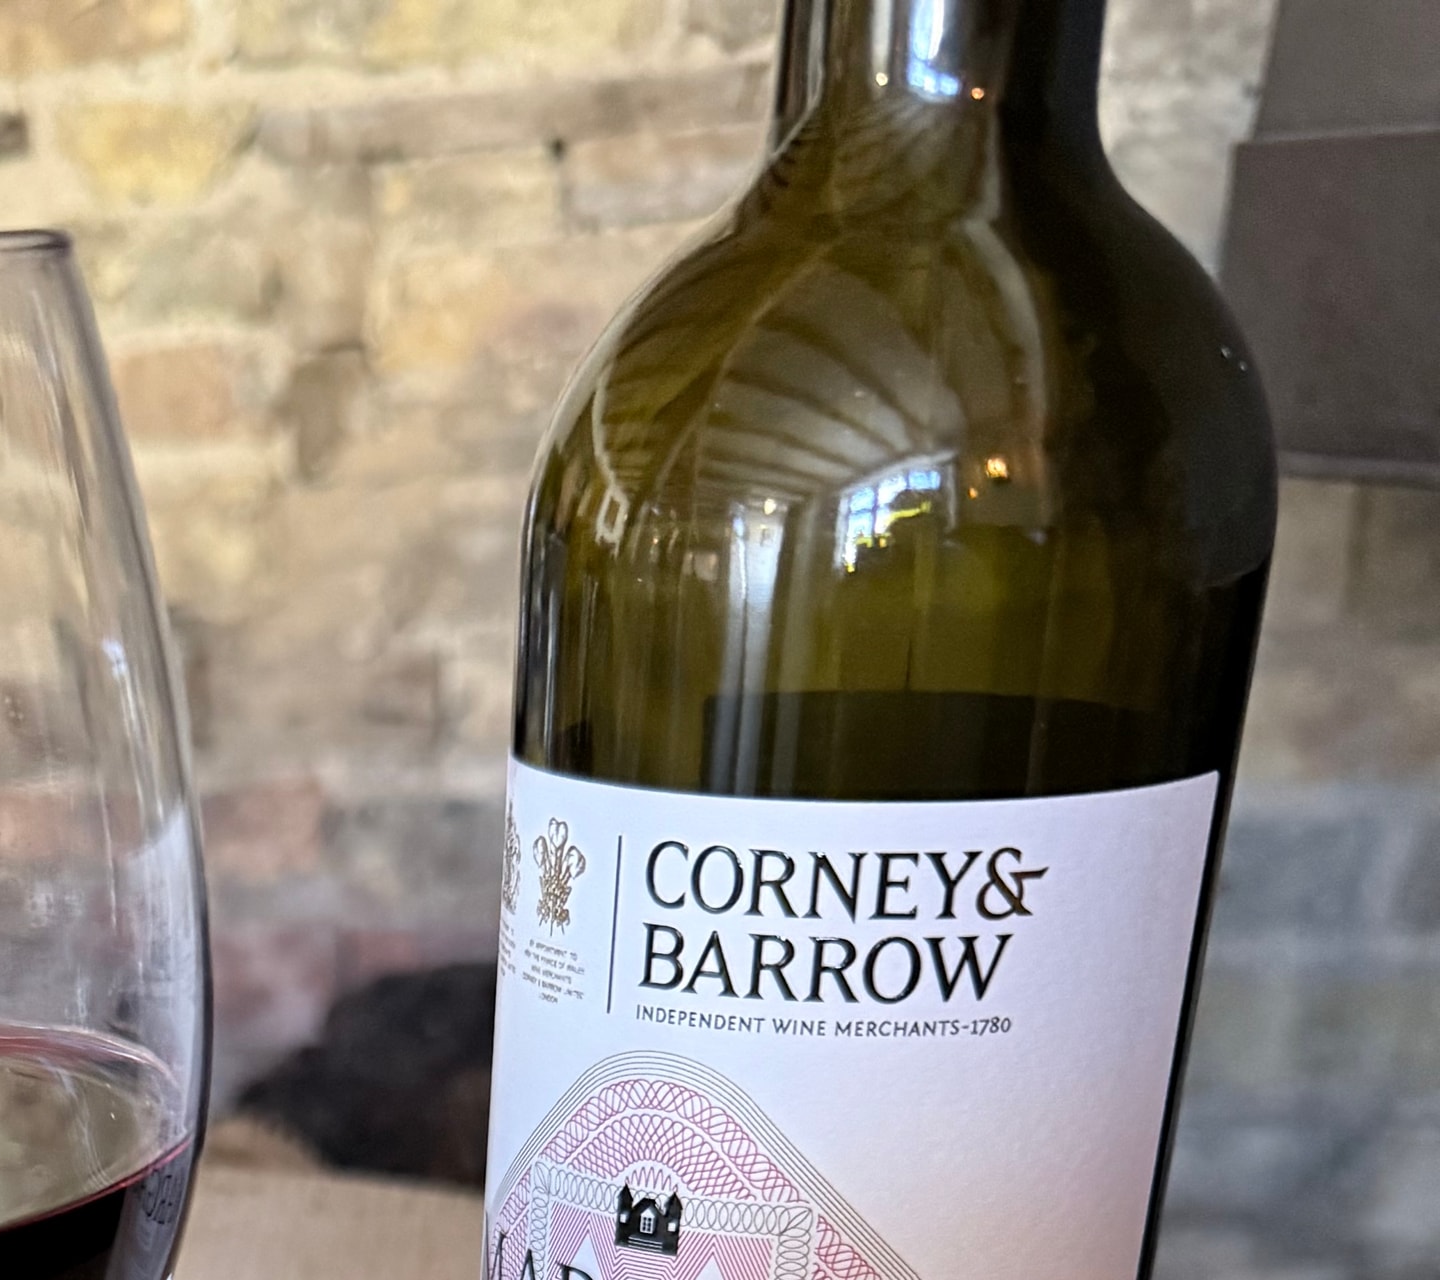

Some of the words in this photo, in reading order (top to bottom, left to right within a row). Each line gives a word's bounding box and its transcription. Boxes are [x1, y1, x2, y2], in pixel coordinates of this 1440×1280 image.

[638, 922, 1014, 1004] BARROW
[636, 1004, 765, 1034] INDEPENDENT
[773, 1018, 826, 1036] WINE
